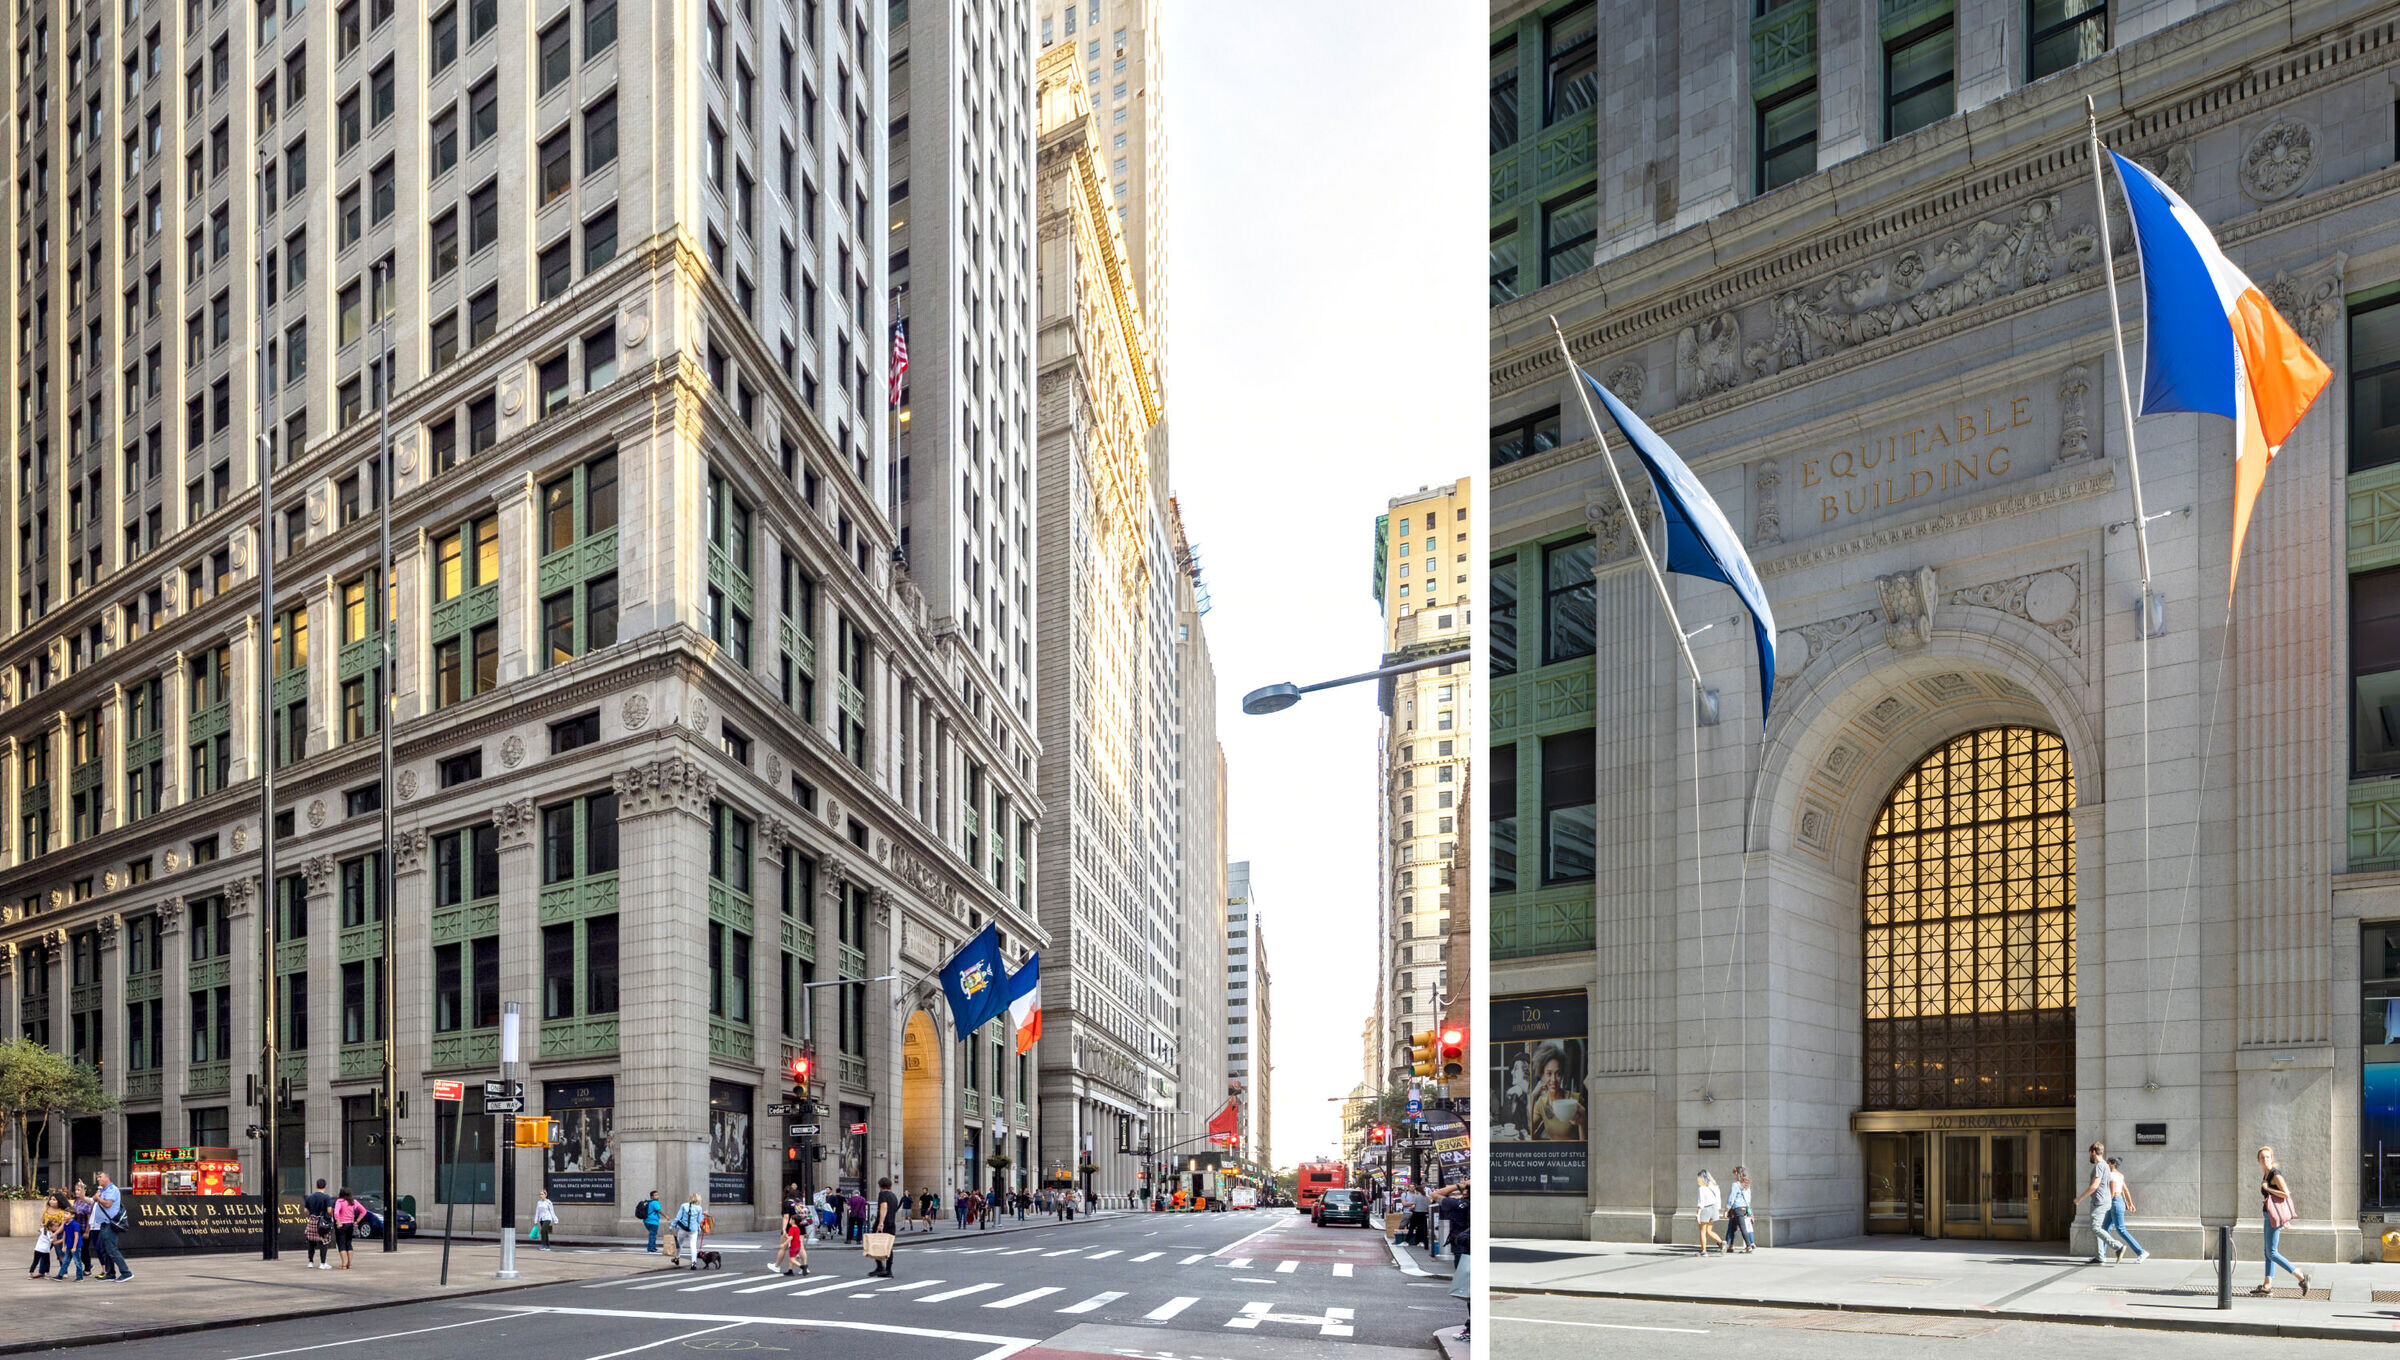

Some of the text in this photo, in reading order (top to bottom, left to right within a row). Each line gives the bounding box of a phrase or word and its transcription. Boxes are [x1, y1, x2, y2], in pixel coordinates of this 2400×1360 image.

[1801, 396, 2033, 488] EQUITABLE
[1821, 446, 2010, 523] BUILDING
[1522, 1008, 1541, 1022] 120
[1512, 1022, 1551, 1032] BROADWAY
[490, 1084, 502, 1092] ONE
[1930, 1114, 2040, 1129] 120 BROADWAY
[140, 1203, 301, 1216] HARRY B. HELMLEY
[138, 1219, 163, 1227] whose
[166, 1218, 198, 1226] richness
[212, 1218, 232, 1227] spirit
[181, 1227, 208, 1235] helped
